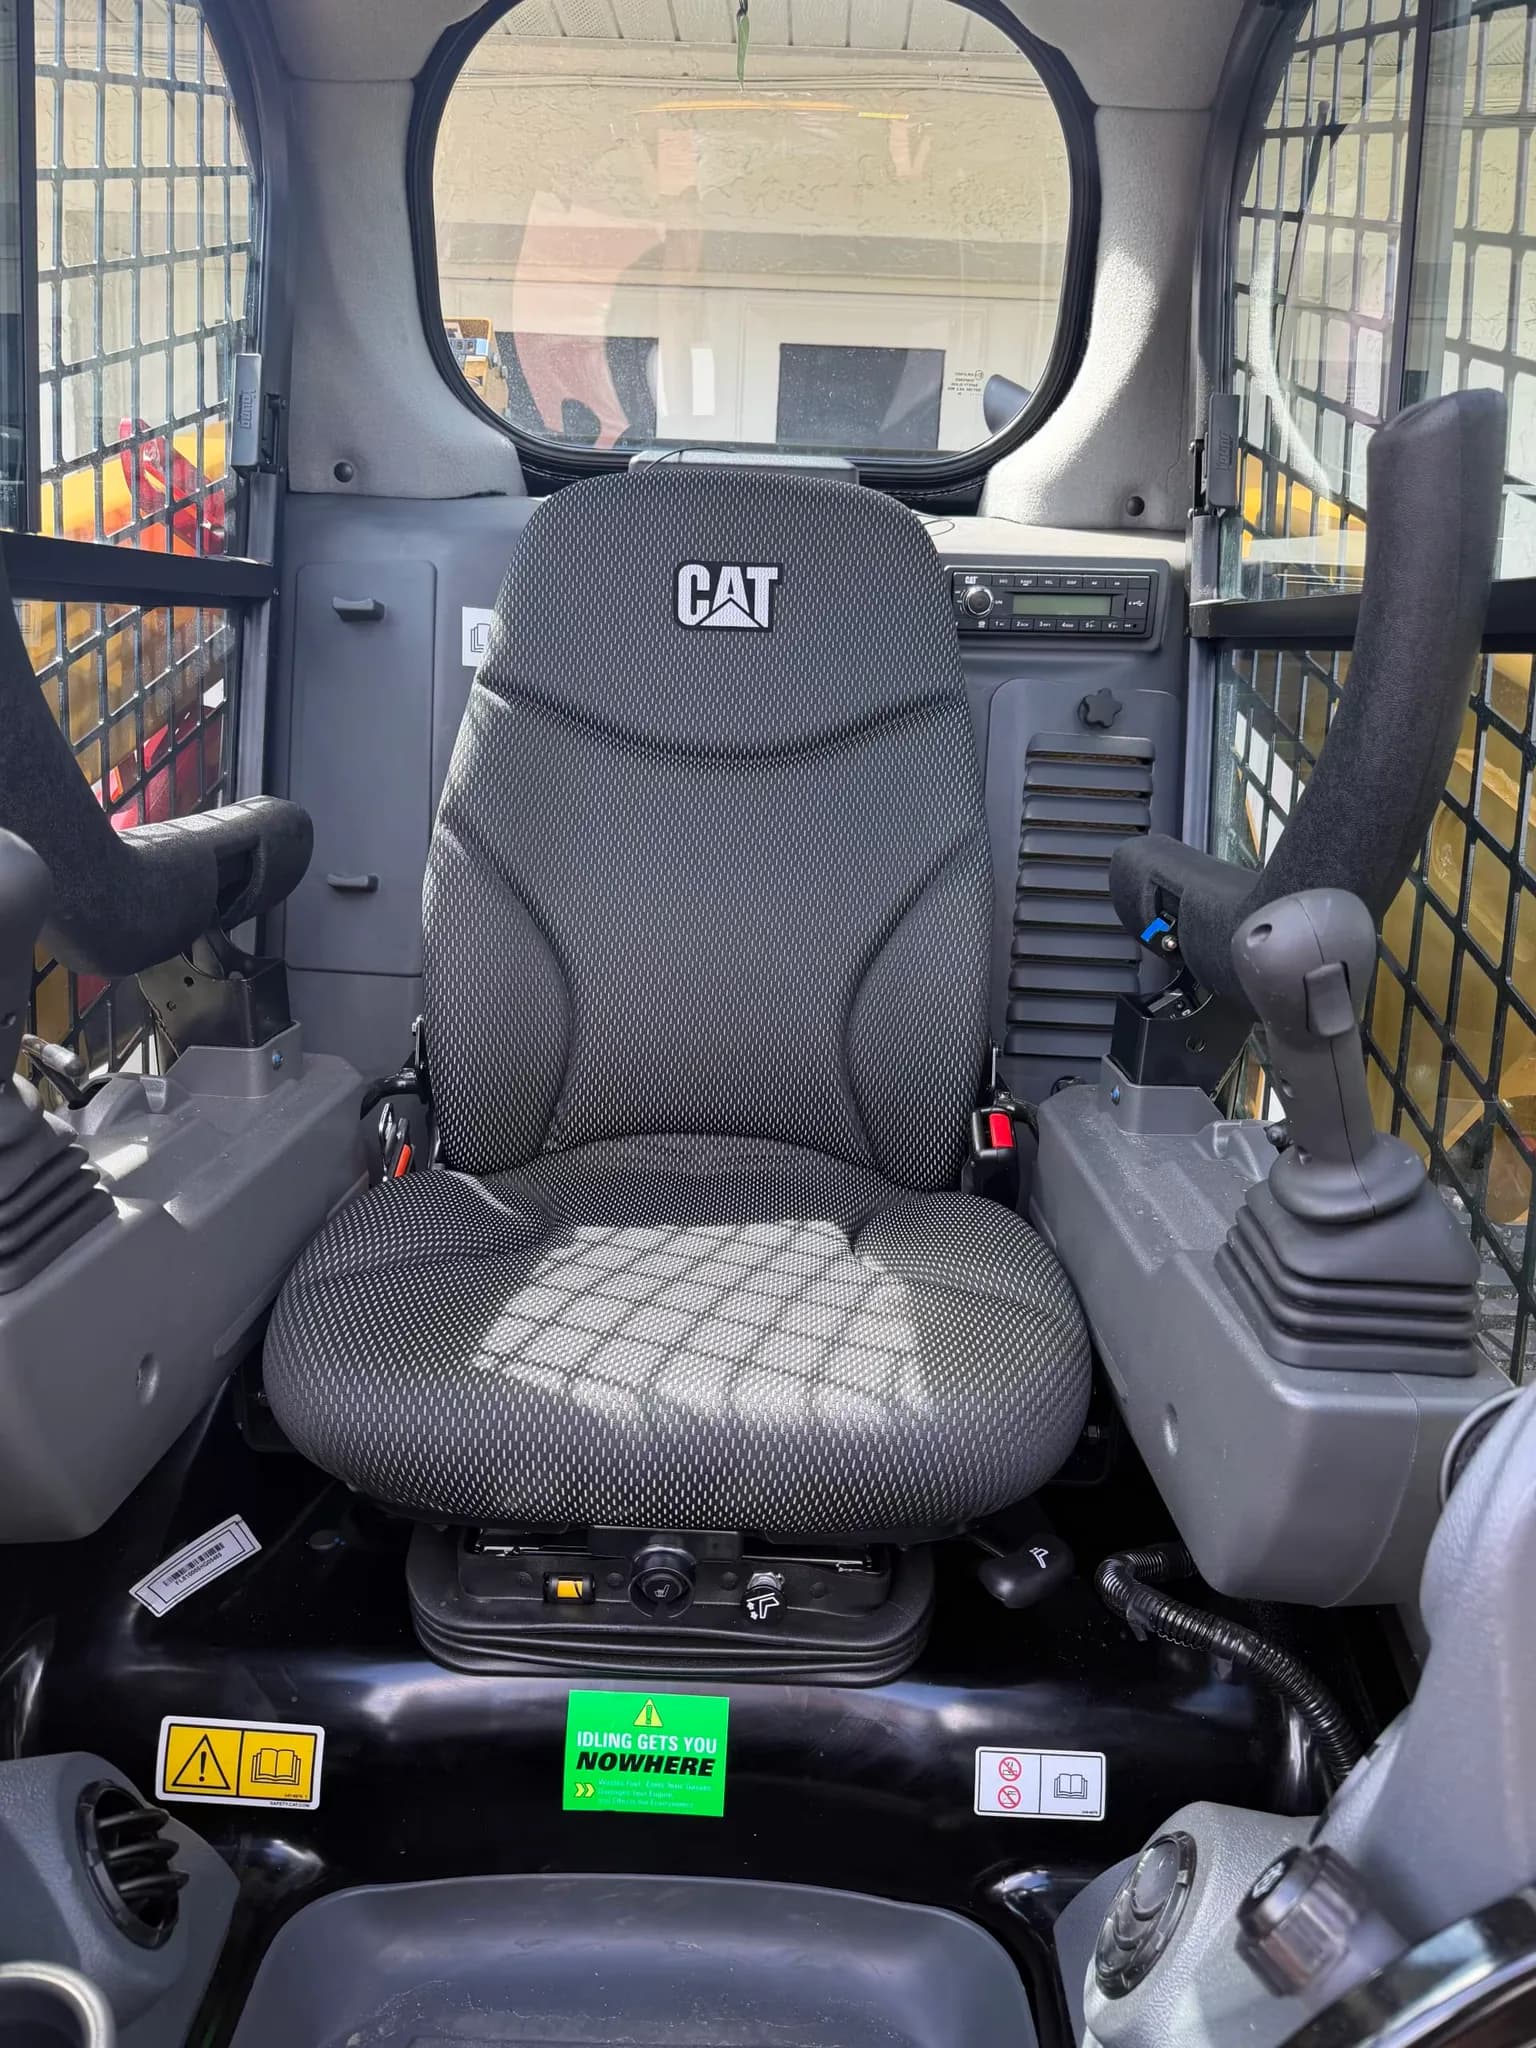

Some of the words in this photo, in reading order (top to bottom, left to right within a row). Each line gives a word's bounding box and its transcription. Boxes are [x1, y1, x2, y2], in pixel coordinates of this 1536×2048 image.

[676, 562, 780, 630] CAT
[577, 1731, 632, 1750] IDLING
[637, 1733, 678, 1751] GETS
[684, 1737, 717, 1754] YOU
[576, 1751, 716, 1777] NOWHERE
